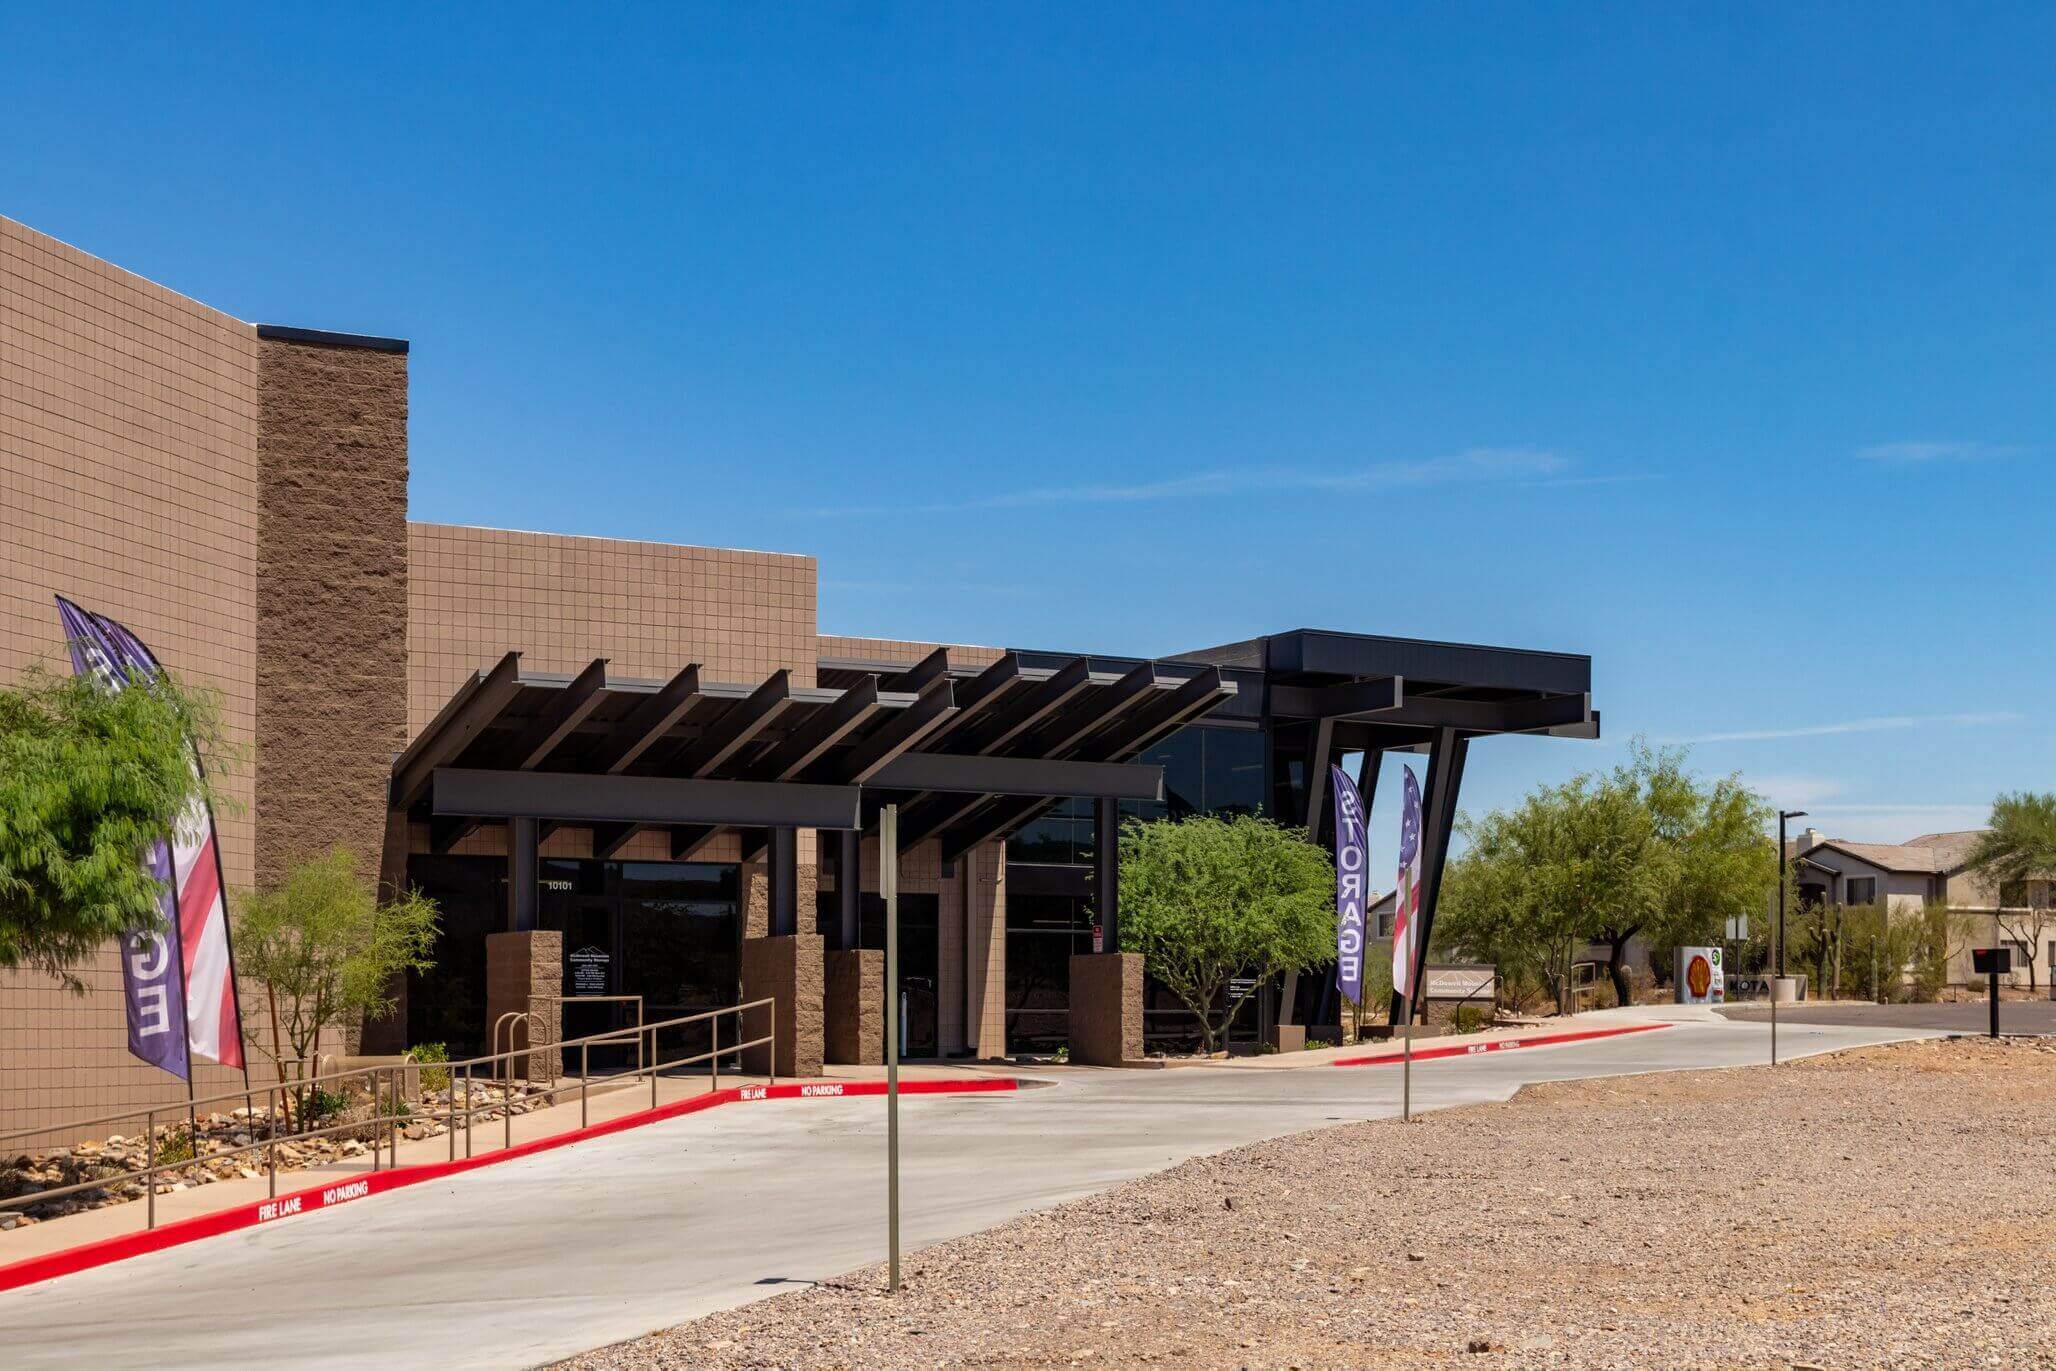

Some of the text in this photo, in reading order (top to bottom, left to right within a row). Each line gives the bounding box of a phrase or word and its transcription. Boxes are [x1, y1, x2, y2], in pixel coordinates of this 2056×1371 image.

[549, 881, 572, 890] 10101
[801, 1084, 843, 1096] NO PARKING
[323, 1180, 368, 1205] NO PARKING
[259, 1197, 302, 1220] FIRE LANE
